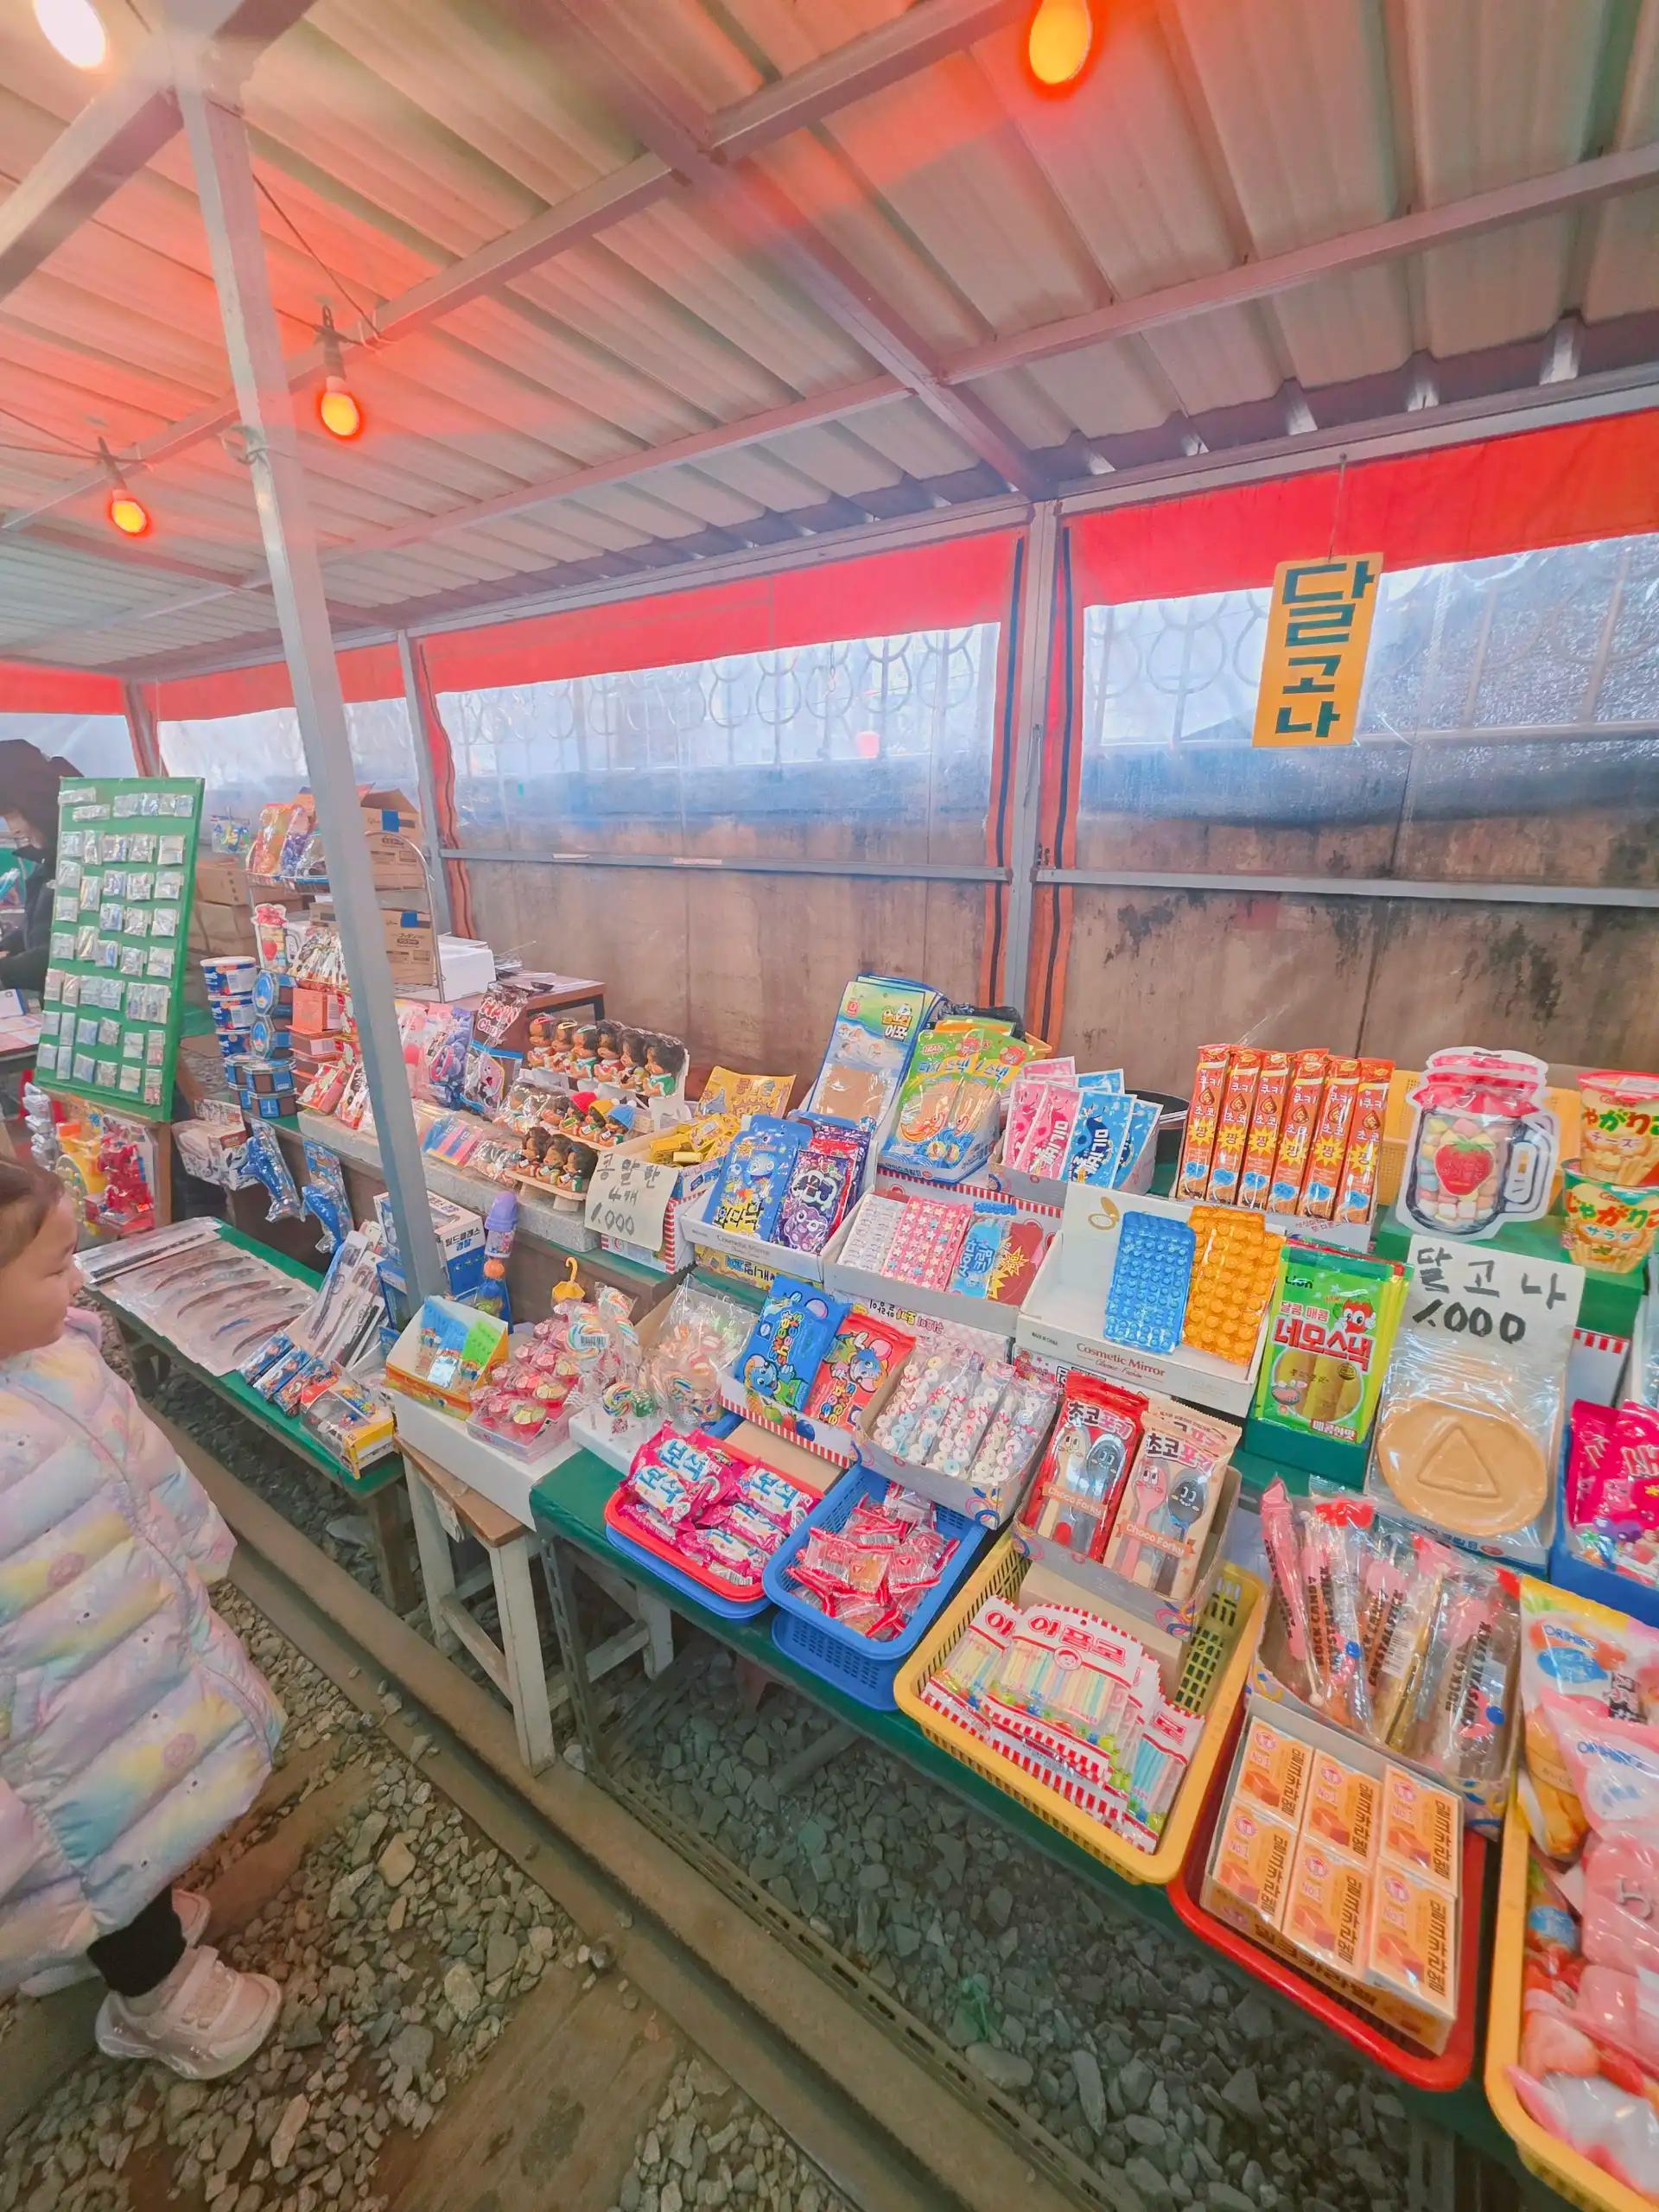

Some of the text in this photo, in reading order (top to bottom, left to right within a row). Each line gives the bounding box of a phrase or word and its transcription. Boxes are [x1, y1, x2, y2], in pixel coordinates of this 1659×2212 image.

[1274, 561, 1376, 737] 달고나
[1255, 1115, 1277, 1126] 초코
[1590, 1130, 1641, 1149] チーズ
[1585, 1224, 1639, 1243] サラダ
[1285, 1275, 1313, 1289] Lion
[869, 1299, 895, 1319] 말랑이
[1280, 1301, 1329, 1322] 달콤 매콤
[1274, 1317, 1373, 1372] 네모스낵
[1076, 1343, 1127, 1365] Cosmetic
[1128, 1358, 1166, 1376] Mirror
[658, 1439, 709, 1482] 보석
[638, 1468, 686, 1504] 보석
[751, 1471, 799, 1509] 보석
[1047, 1486, 1074, 1506] Choco
[1125, 1523, 1185, 1555] Choco Forky
